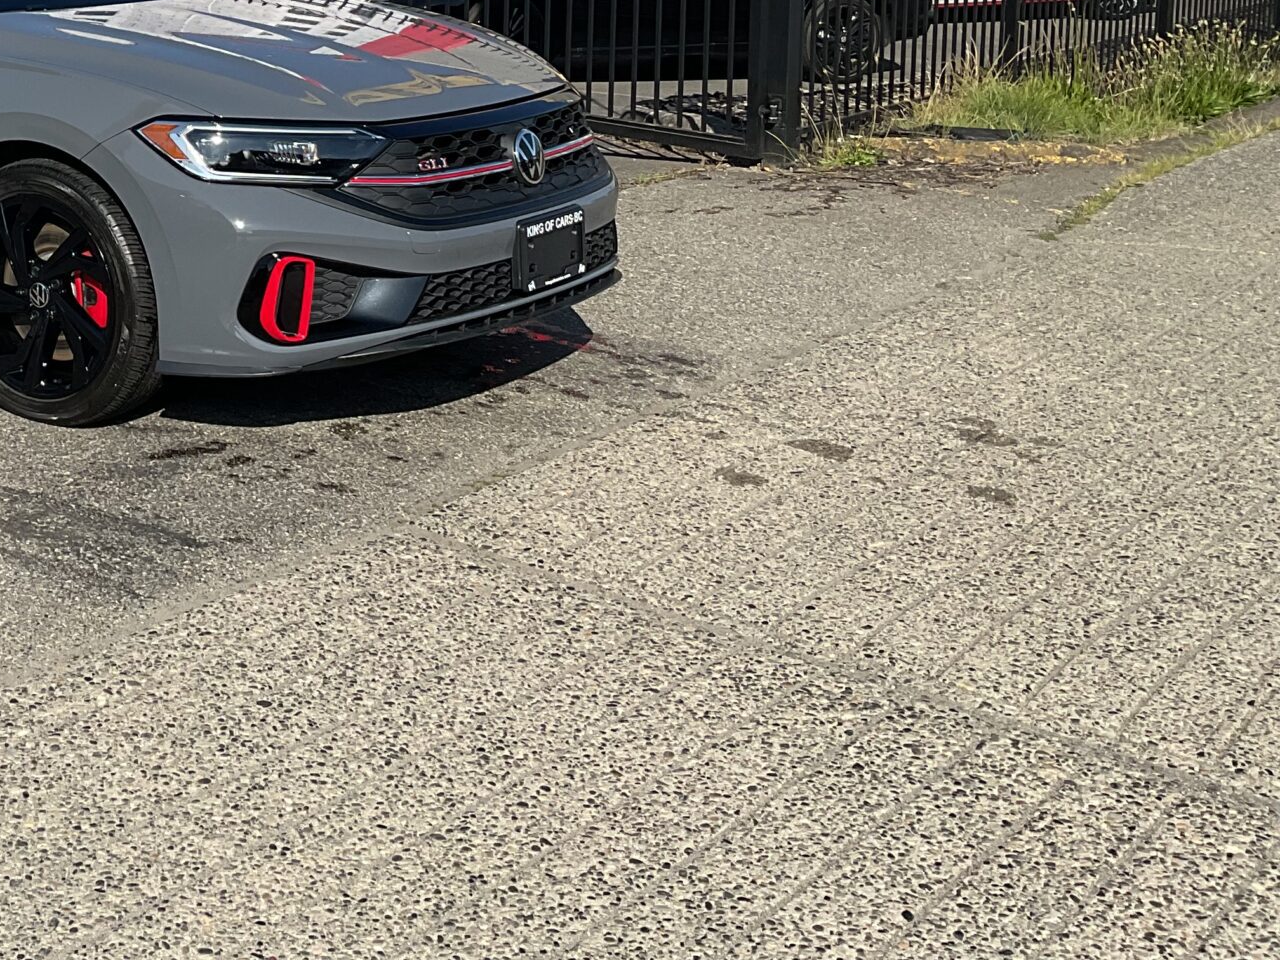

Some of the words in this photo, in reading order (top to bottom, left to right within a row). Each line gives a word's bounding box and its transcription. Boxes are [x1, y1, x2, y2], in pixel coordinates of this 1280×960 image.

[418, 157, 449, 170] GLI
[526, 222, 544, 237] KING
[545, 219, 555, 232] OF
[555, 214, 573, 228] CARS
[574, 210, 583, 223] BC
